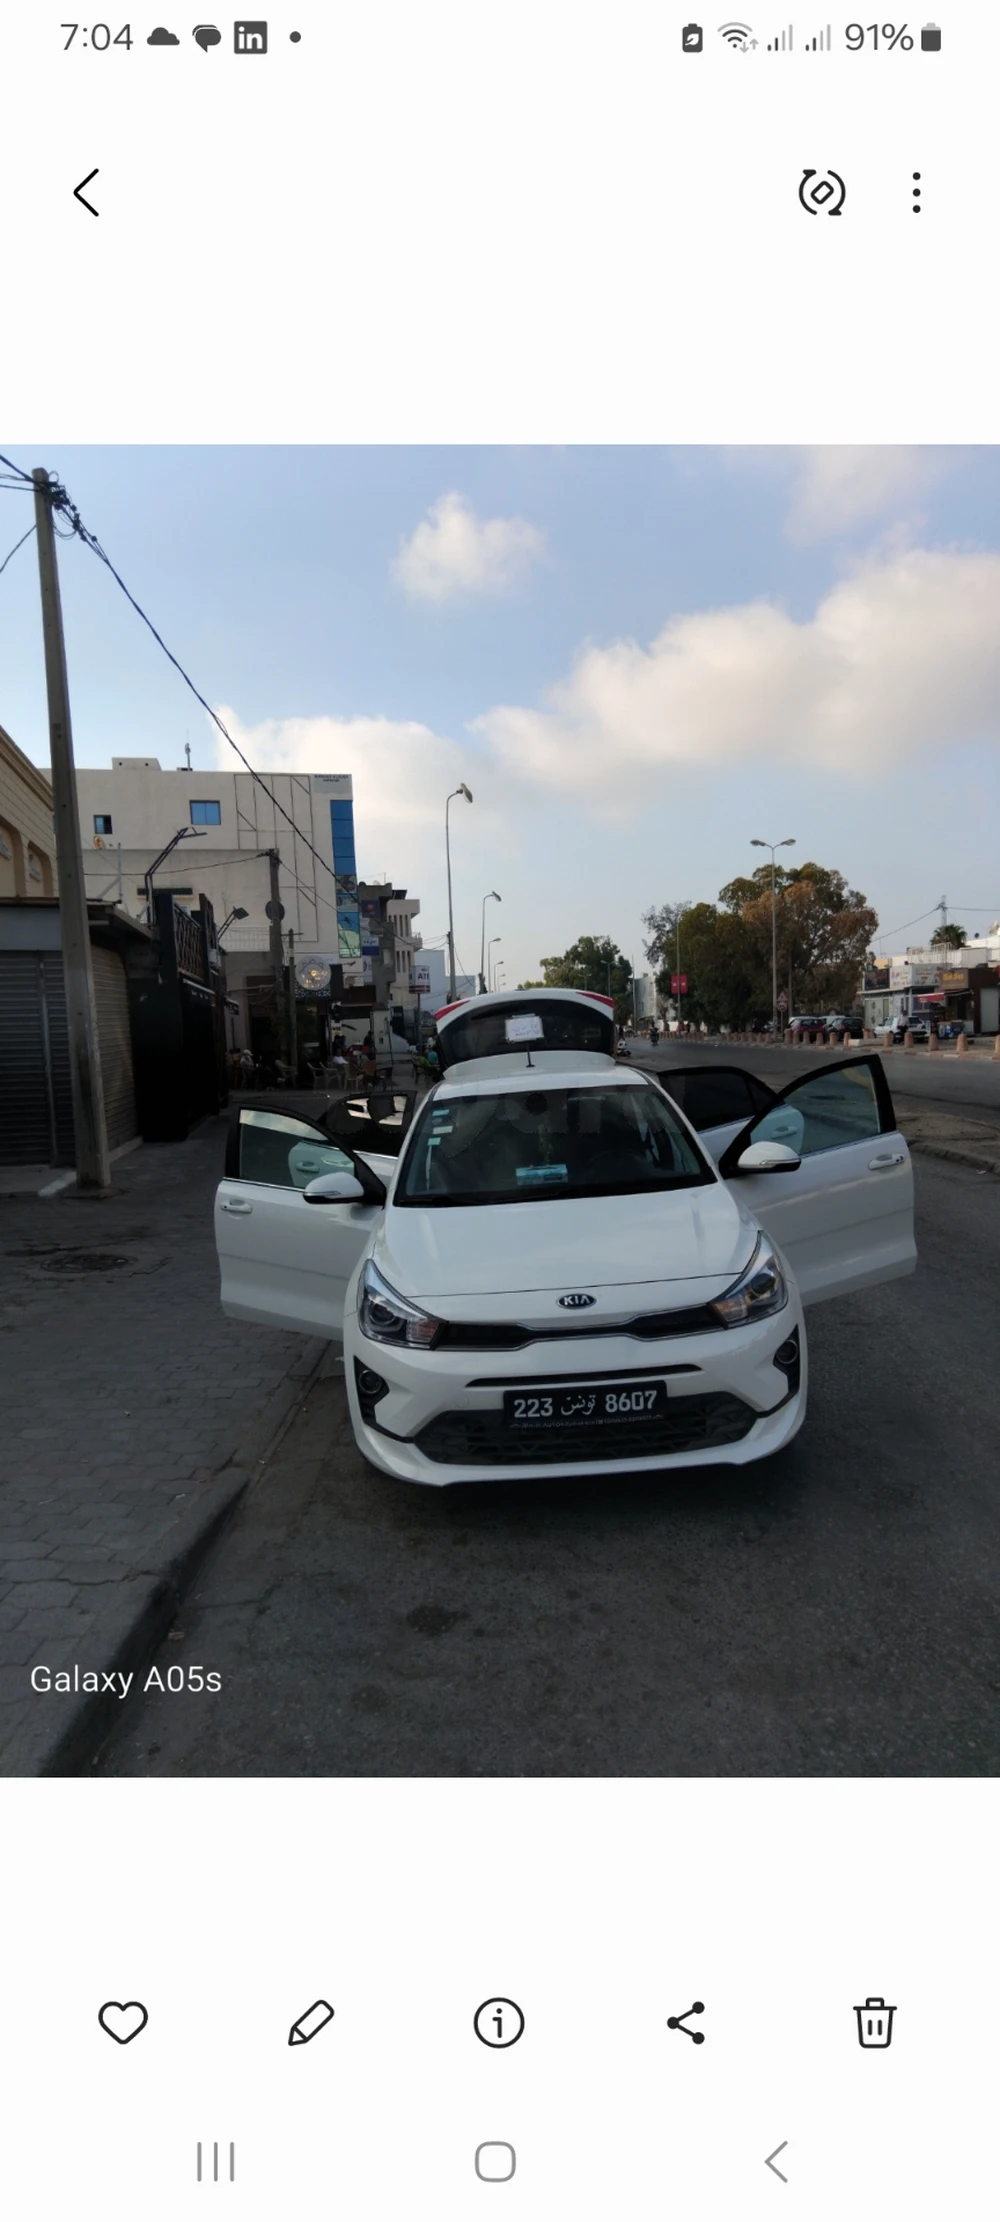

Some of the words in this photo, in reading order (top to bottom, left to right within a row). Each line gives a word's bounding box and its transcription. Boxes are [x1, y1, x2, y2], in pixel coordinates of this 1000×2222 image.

[60, 23, 134, 51] 7:04
[238, 26, 263, 50] in
[845, 23, 914, 51] 91%
[514, 1397, 553, 1418] 223
[561, 1394, 597, 1416] تونس
[605, 1390, 657, 1413] 8607
